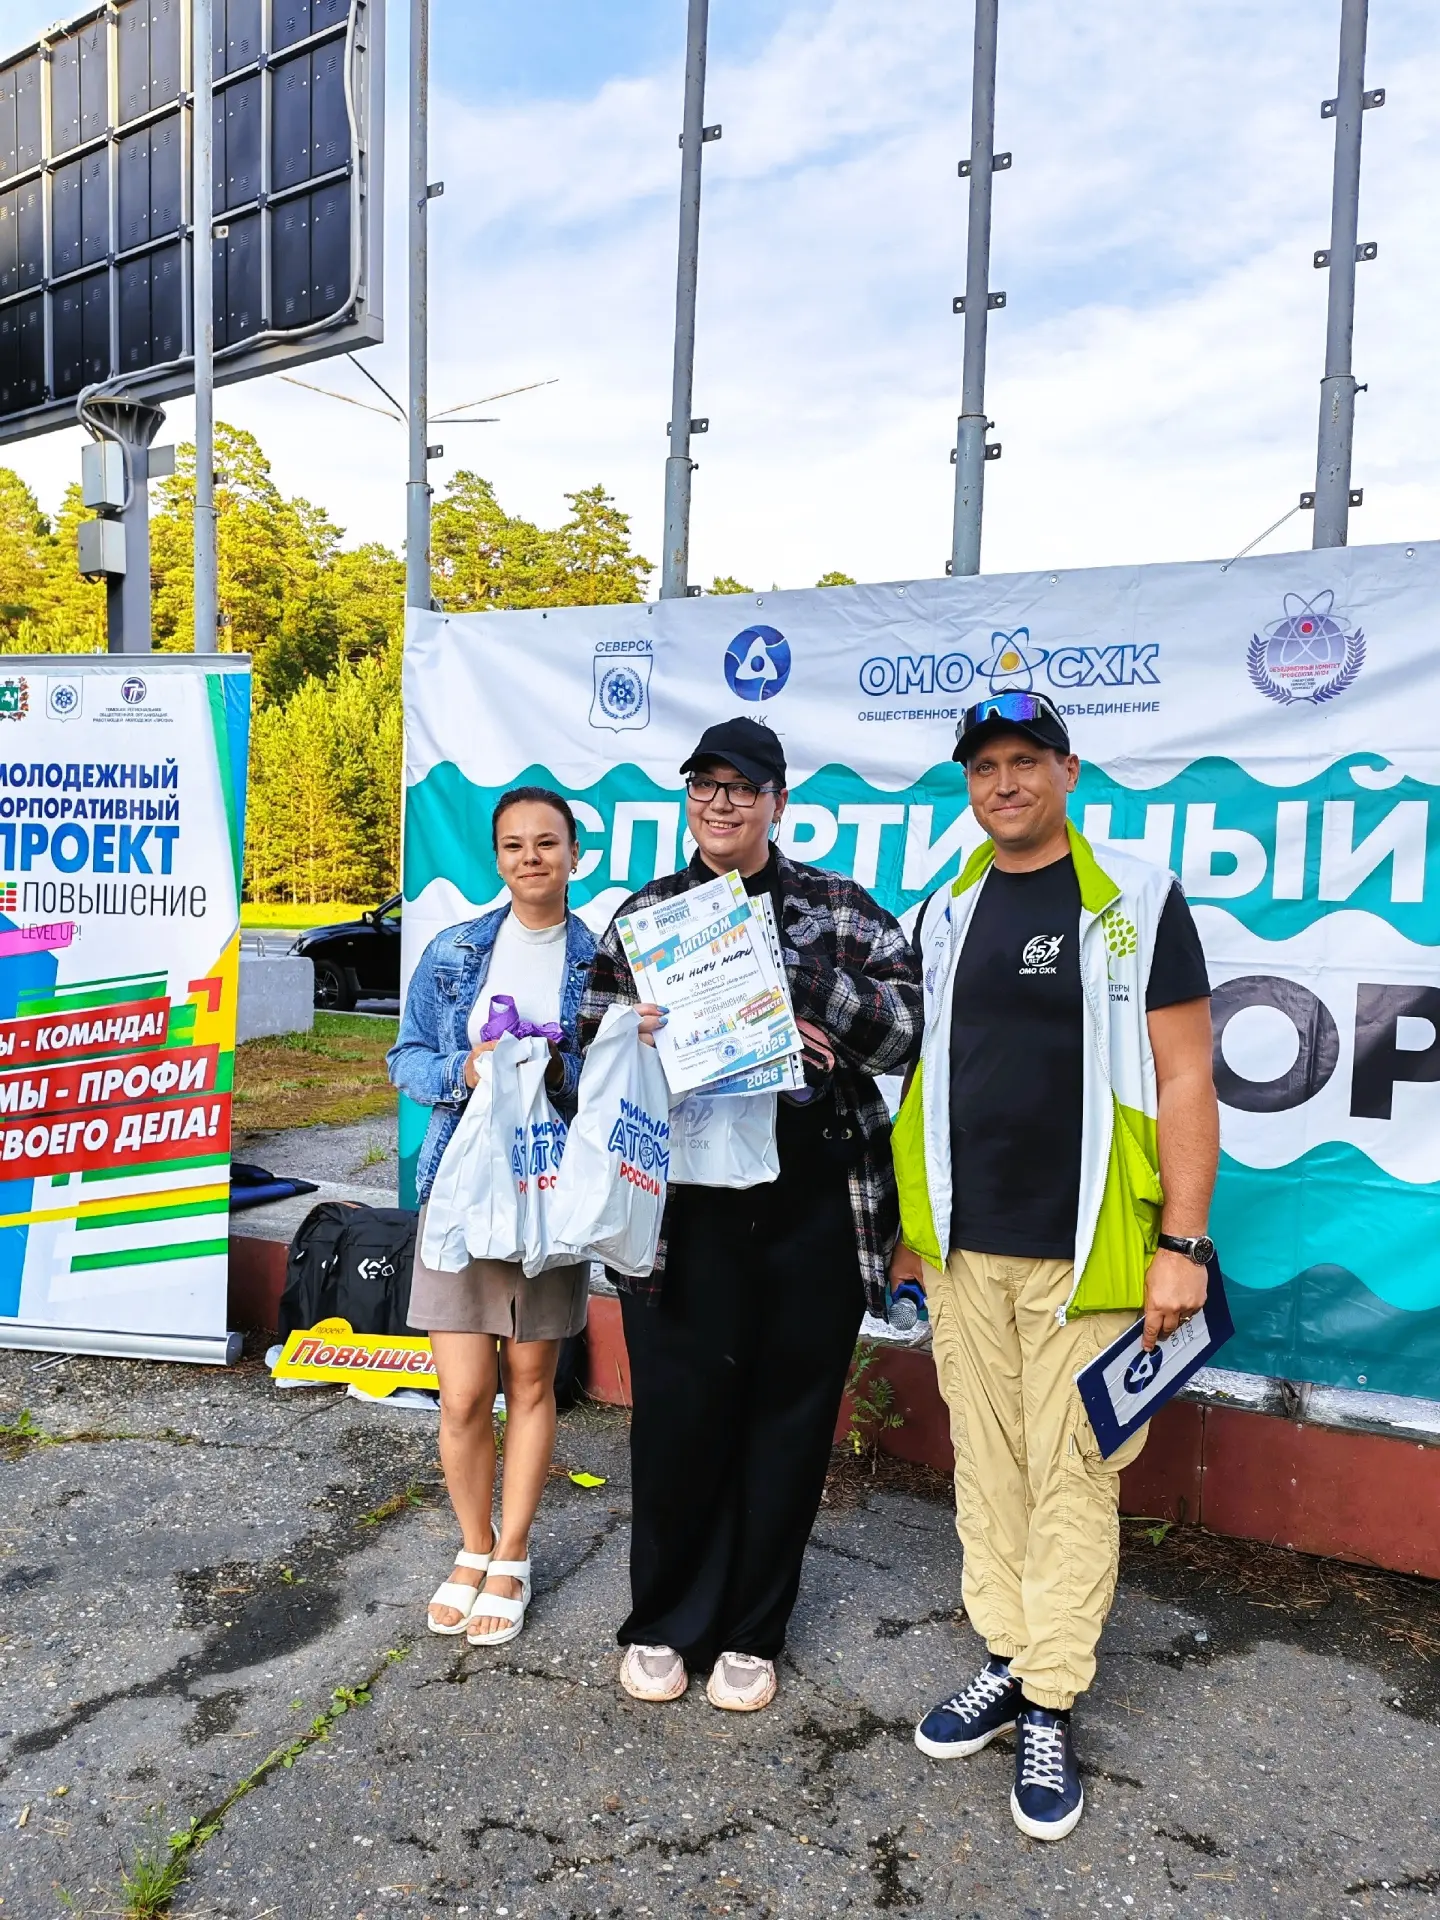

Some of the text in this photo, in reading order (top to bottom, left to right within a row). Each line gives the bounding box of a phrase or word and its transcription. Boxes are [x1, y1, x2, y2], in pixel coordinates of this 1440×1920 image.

[595, 640, 653, 653] СЕВЕРСК
[859, 643, 1161, 696] ОМО СХК
[857, 709, 957, 722] ОБЩЕСТВЕННОЕ
[1058, 701, 1160, 716] ОБЪЕДИНЕНИЕ
[0, 794, 180, 821] ОРПОРАТИВНЫЙ
[0, 822, 180, 875] ПРОЕКТ
[656, 908, 691, 929] ПРОЕКТ
[21, 923, 82, 941] LEVEL UP!
[673, 916, 732, 962] ДИПЛОМ
[721, 923, 747, 948] ТУР
[1026, 945, 1047, 959] 25
[1019, 967, 1057, 975] ОМО СХК
[1108, 985, 1130, 993] ТЕРЫ
[35, 1012, 165, 1052] КОМАНДА!
[755, 1033, 787, 1058] 2026
[1212, 975, 1440, 1120] ОР
[0, 1077, 48, 1112] МЫ
[77, 1058, 209, 1104] ПРОФИ
[747, 1066, 779, 1088] 2026
[113, 1105, 221, 1154] ДЕЛА!
[608, 1118, 669, 1182] АТОМ
[620, 1161, 660, 1197] РОССИИ
